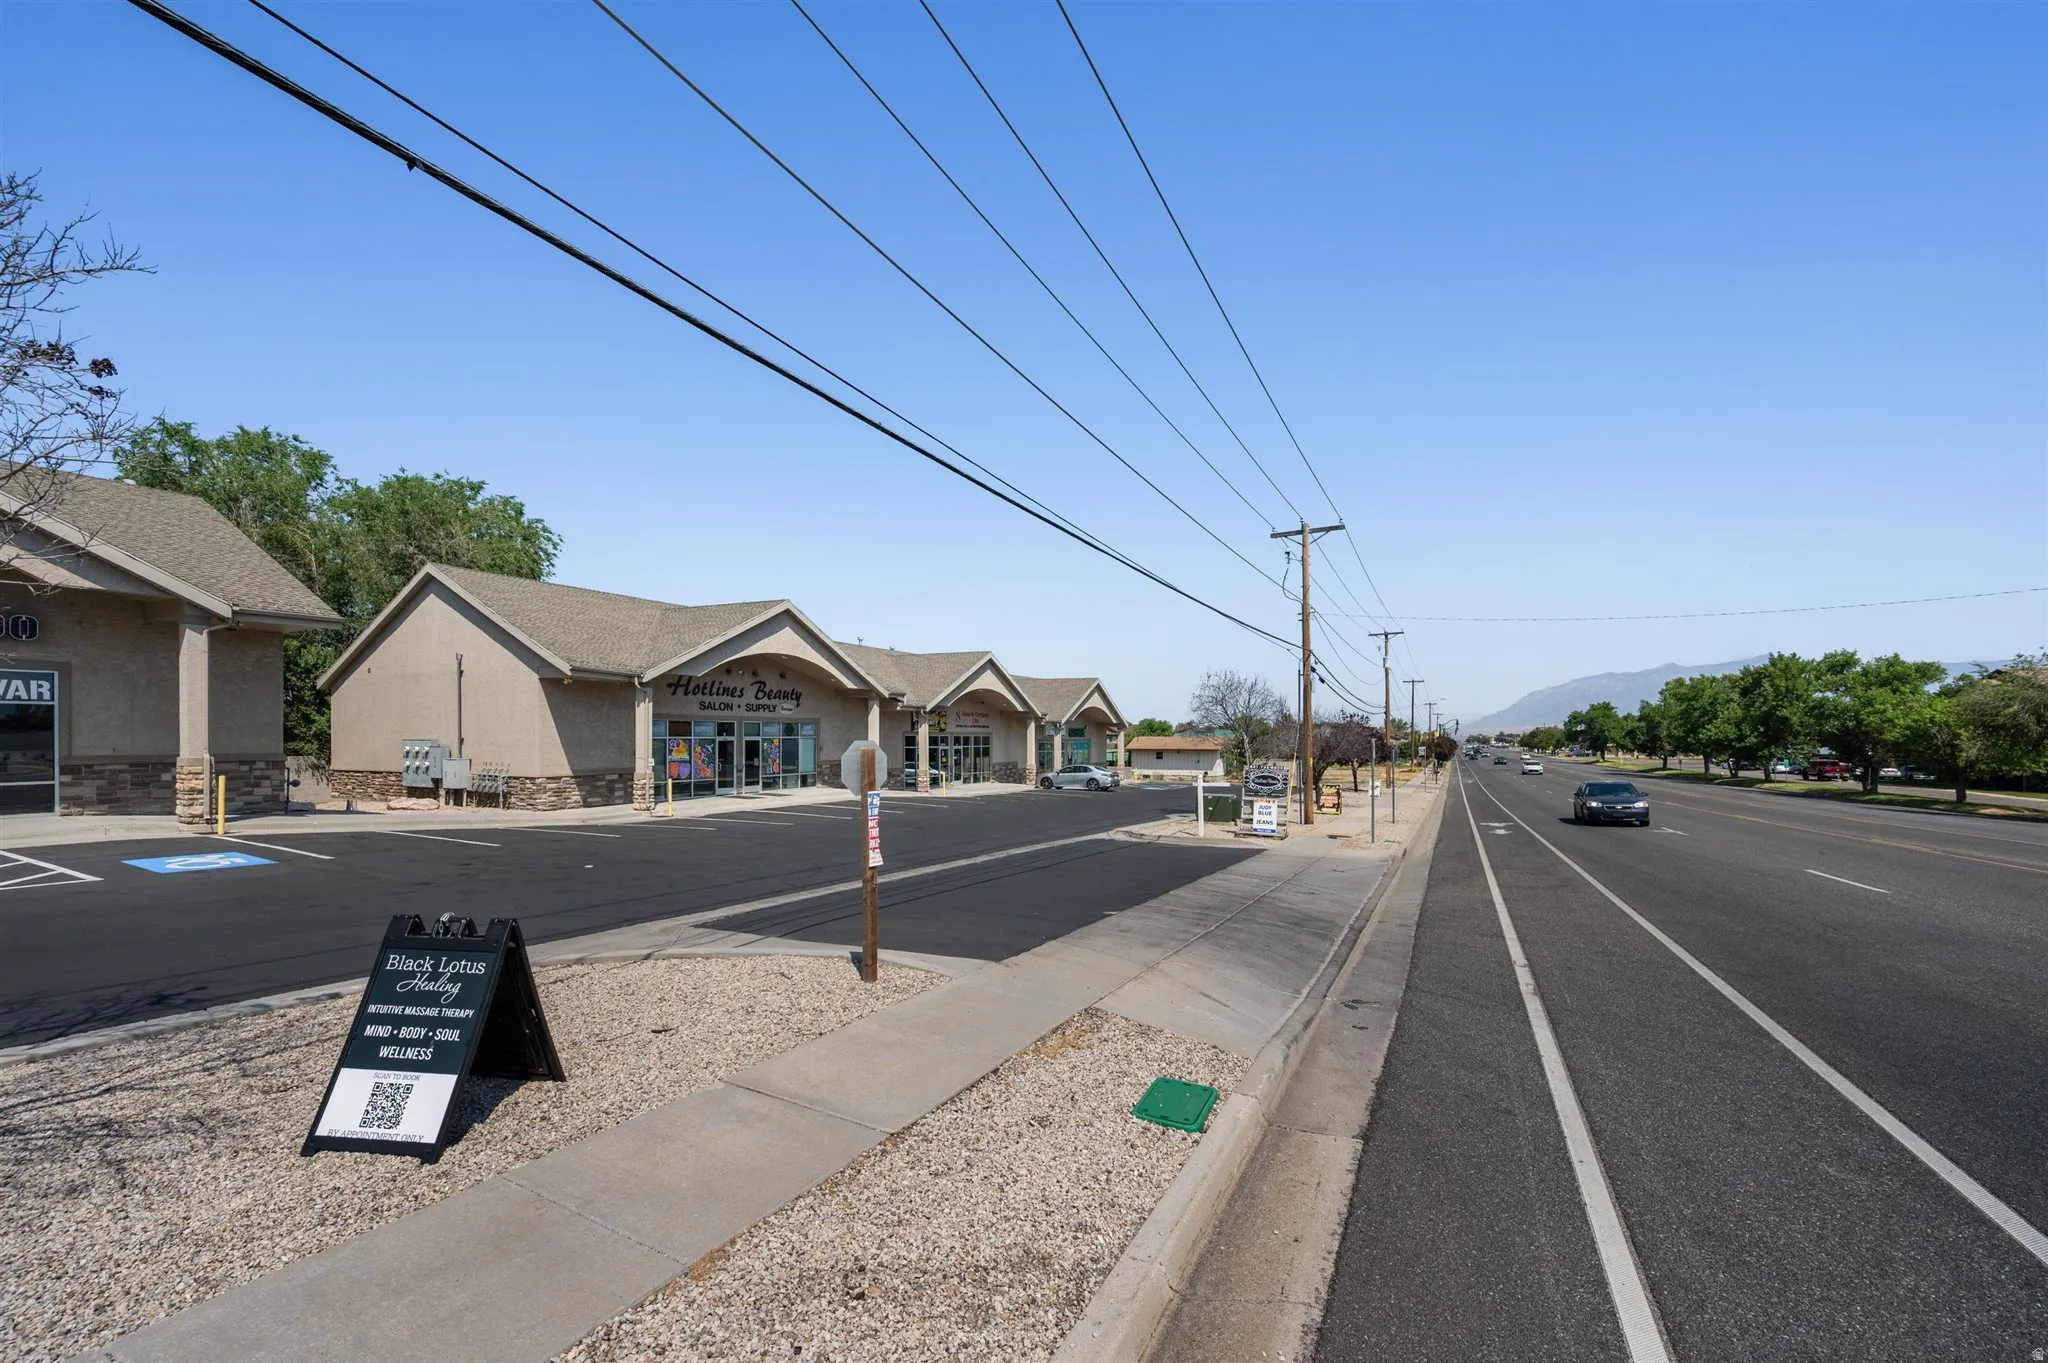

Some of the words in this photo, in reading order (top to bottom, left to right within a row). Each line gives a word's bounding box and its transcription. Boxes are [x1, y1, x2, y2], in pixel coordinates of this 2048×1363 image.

[666, 675, 744, 698] Hotlines
[751, 680, 802, 707] Beauty
[699, 701, 734, 711] SALON
[745, 703, 777, 713] SUPPLY
[385, 955, 434, 972] Black
[438, 957, 486, 975] Lotus
[396, 973, 462, 1004] Healing
[367, 1004, 404, 1015] INTUITIVE
[404, 1006, 440, 1017] MASSAGE
[441, 1007, 475, 1019] THERAPY
[364, 1025, 392, 1037] MIND
[399, 1027, 428, 1040] BODY
[434, 1028, 461, 1042] SOUL
[378, 1046, 433, 1061] WELLNESS
[373, 1072, 391, 1080] SCAN
[327, 1128, 339, 1137] BY
[340, 1129, 400, 1141] APPOINTMENT
[401, 1133, 425, 1143] ONLY
